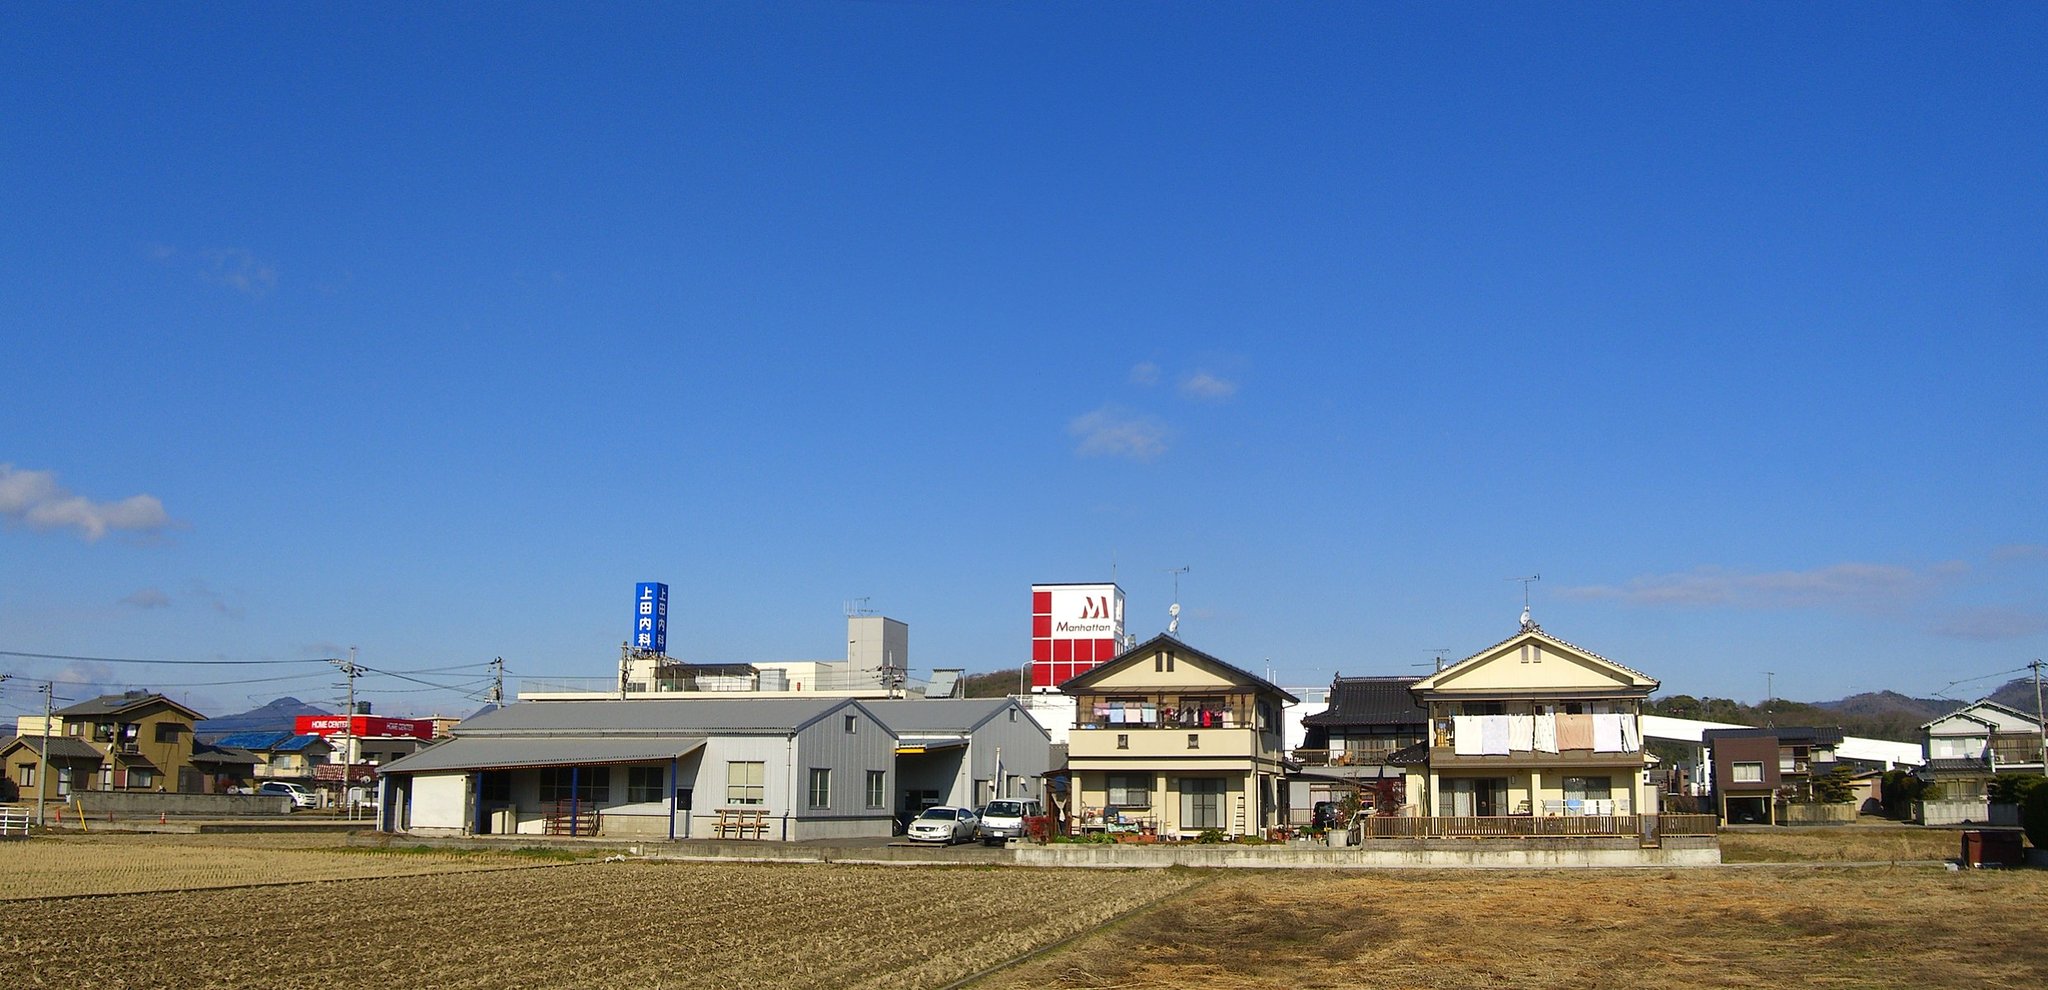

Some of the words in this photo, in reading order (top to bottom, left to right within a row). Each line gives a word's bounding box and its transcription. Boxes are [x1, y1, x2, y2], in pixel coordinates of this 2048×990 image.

[638, 586, 653, 647] 上田内科
[657, 588, 666, 648] 上田内科
[1056, 621, 1110, 632] Manhattan
[311, 720, 328, 729] HOME
